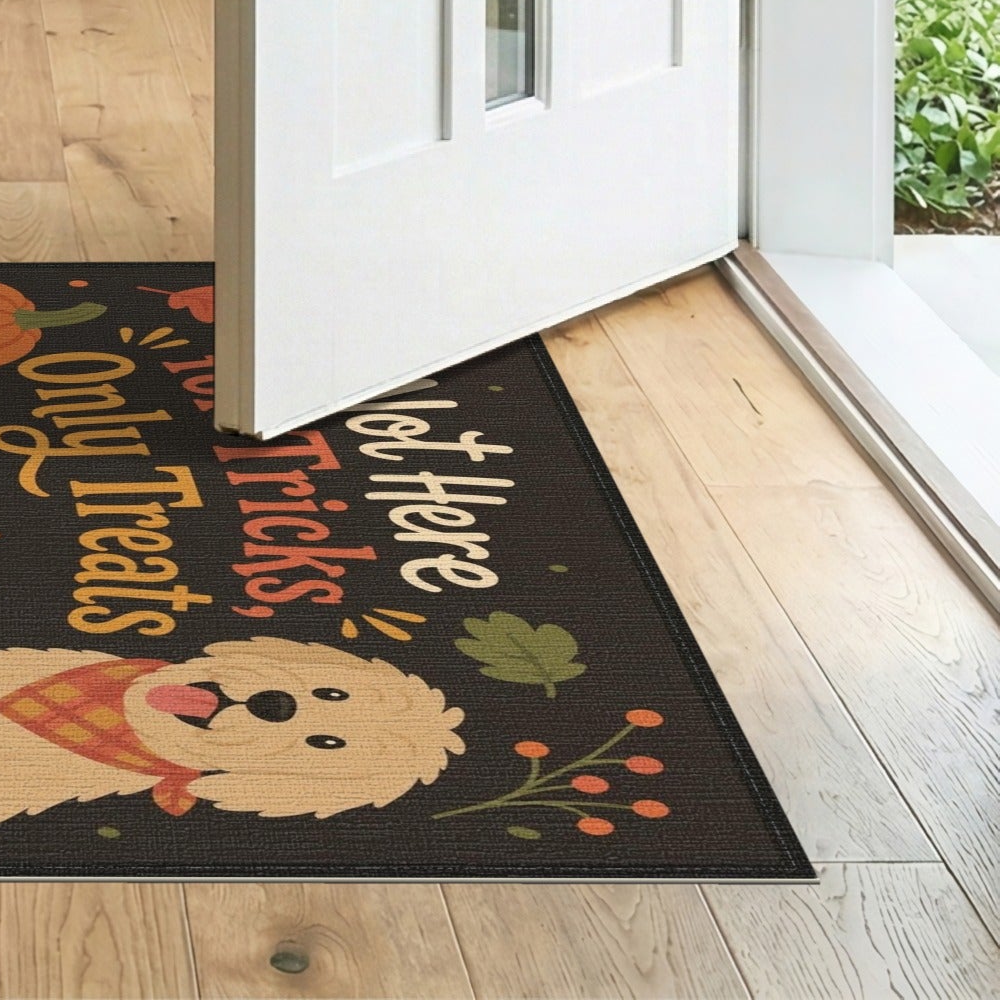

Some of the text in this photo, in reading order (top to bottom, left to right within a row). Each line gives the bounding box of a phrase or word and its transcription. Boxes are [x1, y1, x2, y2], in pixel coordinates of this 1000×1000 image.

[66, 465, 213, 636] Treats
[213, 430, 378, 618] Tricks,
[364, 471, 515, 593] Here
